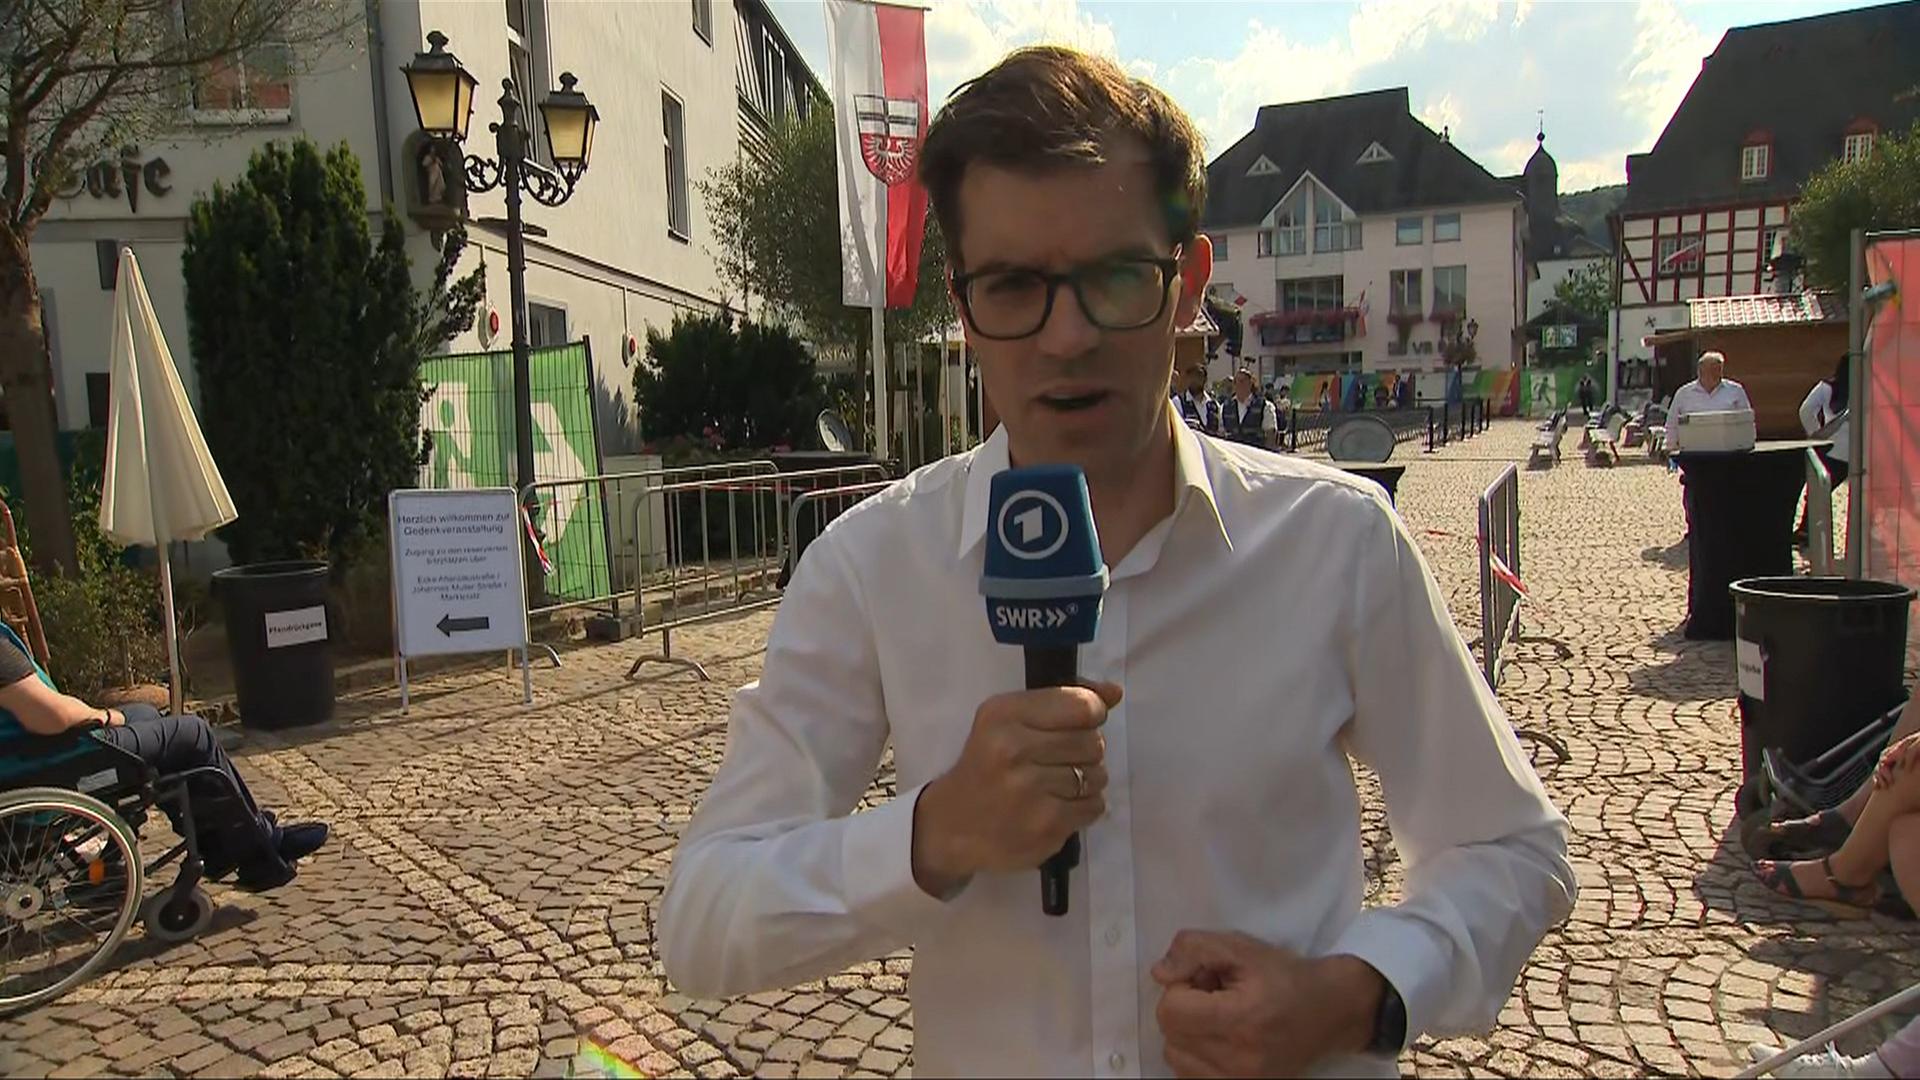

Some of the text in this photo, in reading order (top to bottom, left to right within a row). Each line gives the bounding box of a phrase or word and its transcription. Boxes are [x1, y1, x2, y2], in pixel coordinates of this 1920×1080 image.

[397, 514, 437, 525] Herzlich
[440, 513, 494, 523] willkommen
[403, 524, 504, 536] Gedenkveranstaltung
[996, 606, 1044, 628] SWR
